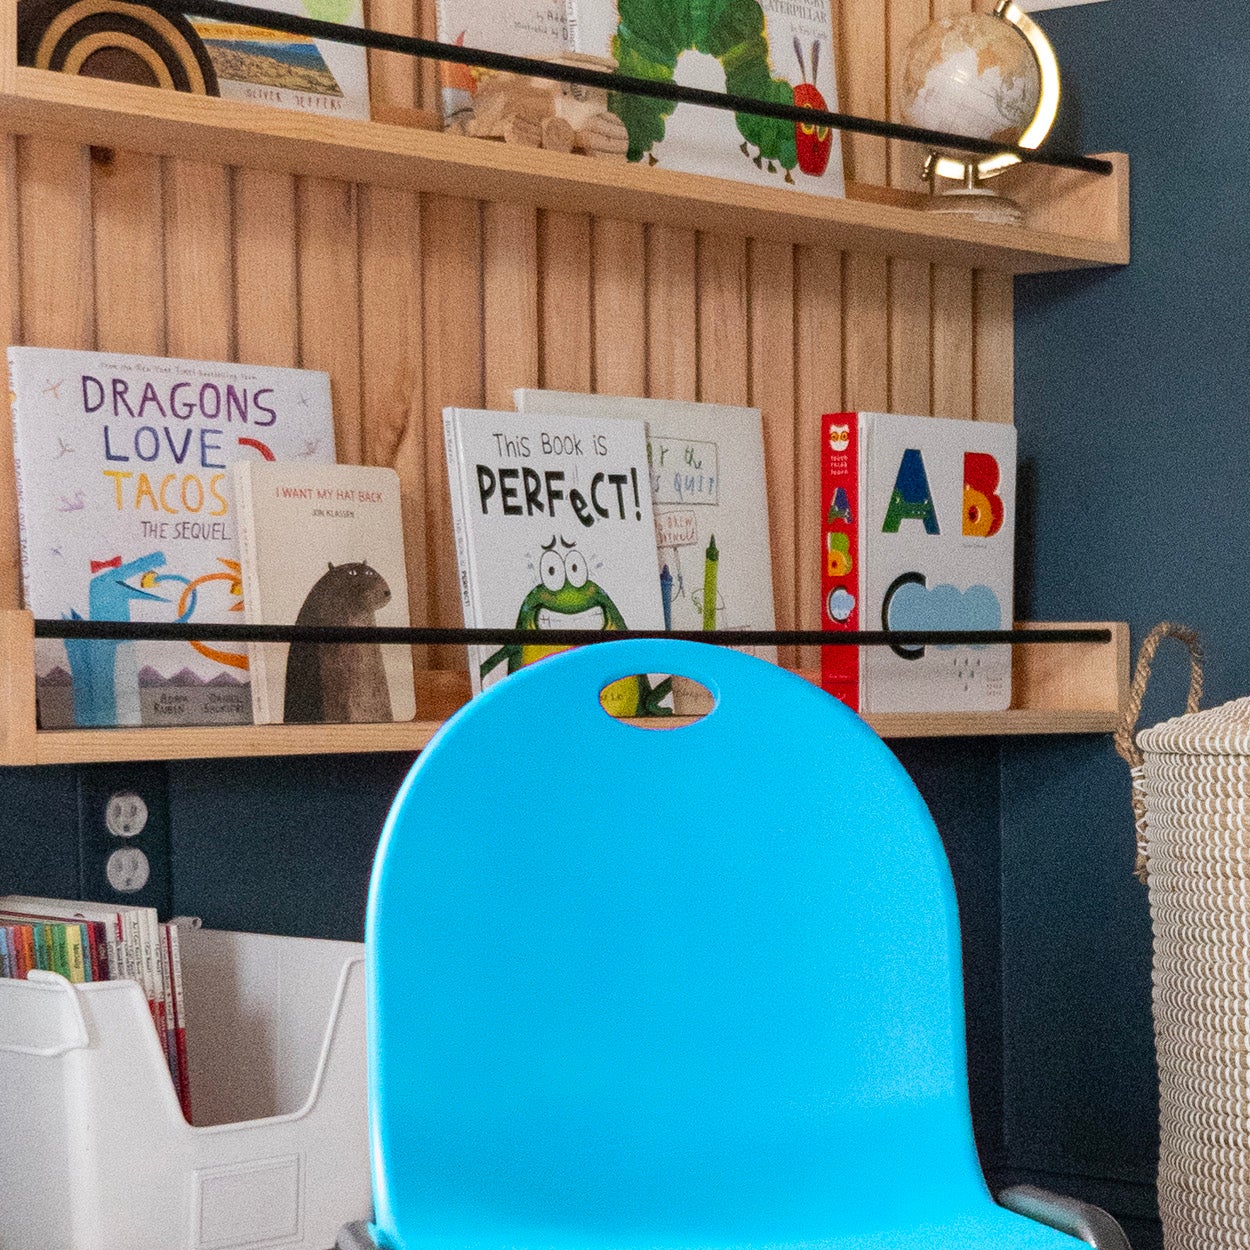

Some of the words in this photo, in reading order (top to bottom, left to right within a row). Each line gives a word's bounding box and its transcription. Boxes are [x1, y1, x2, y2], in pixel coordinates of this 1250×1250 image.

[82, 375, 277, 427] DRAGONS
[103, 424, 226, 469] LOVE
[102, 469, 228, 516] TACOS
[275, 487, 280, 498] I
[281, 487, 313, 500] WANT
[316, 488, 333, 501] MY
[336, 489, 355, 502] HAT
[358, 490, 384, 503] BACK
[882, 448, 941, 535] A
[961, 451, 1005, 539] B
[140, 520, 170, 540] THE
[172, 521, 232, 541] SEQUEL
